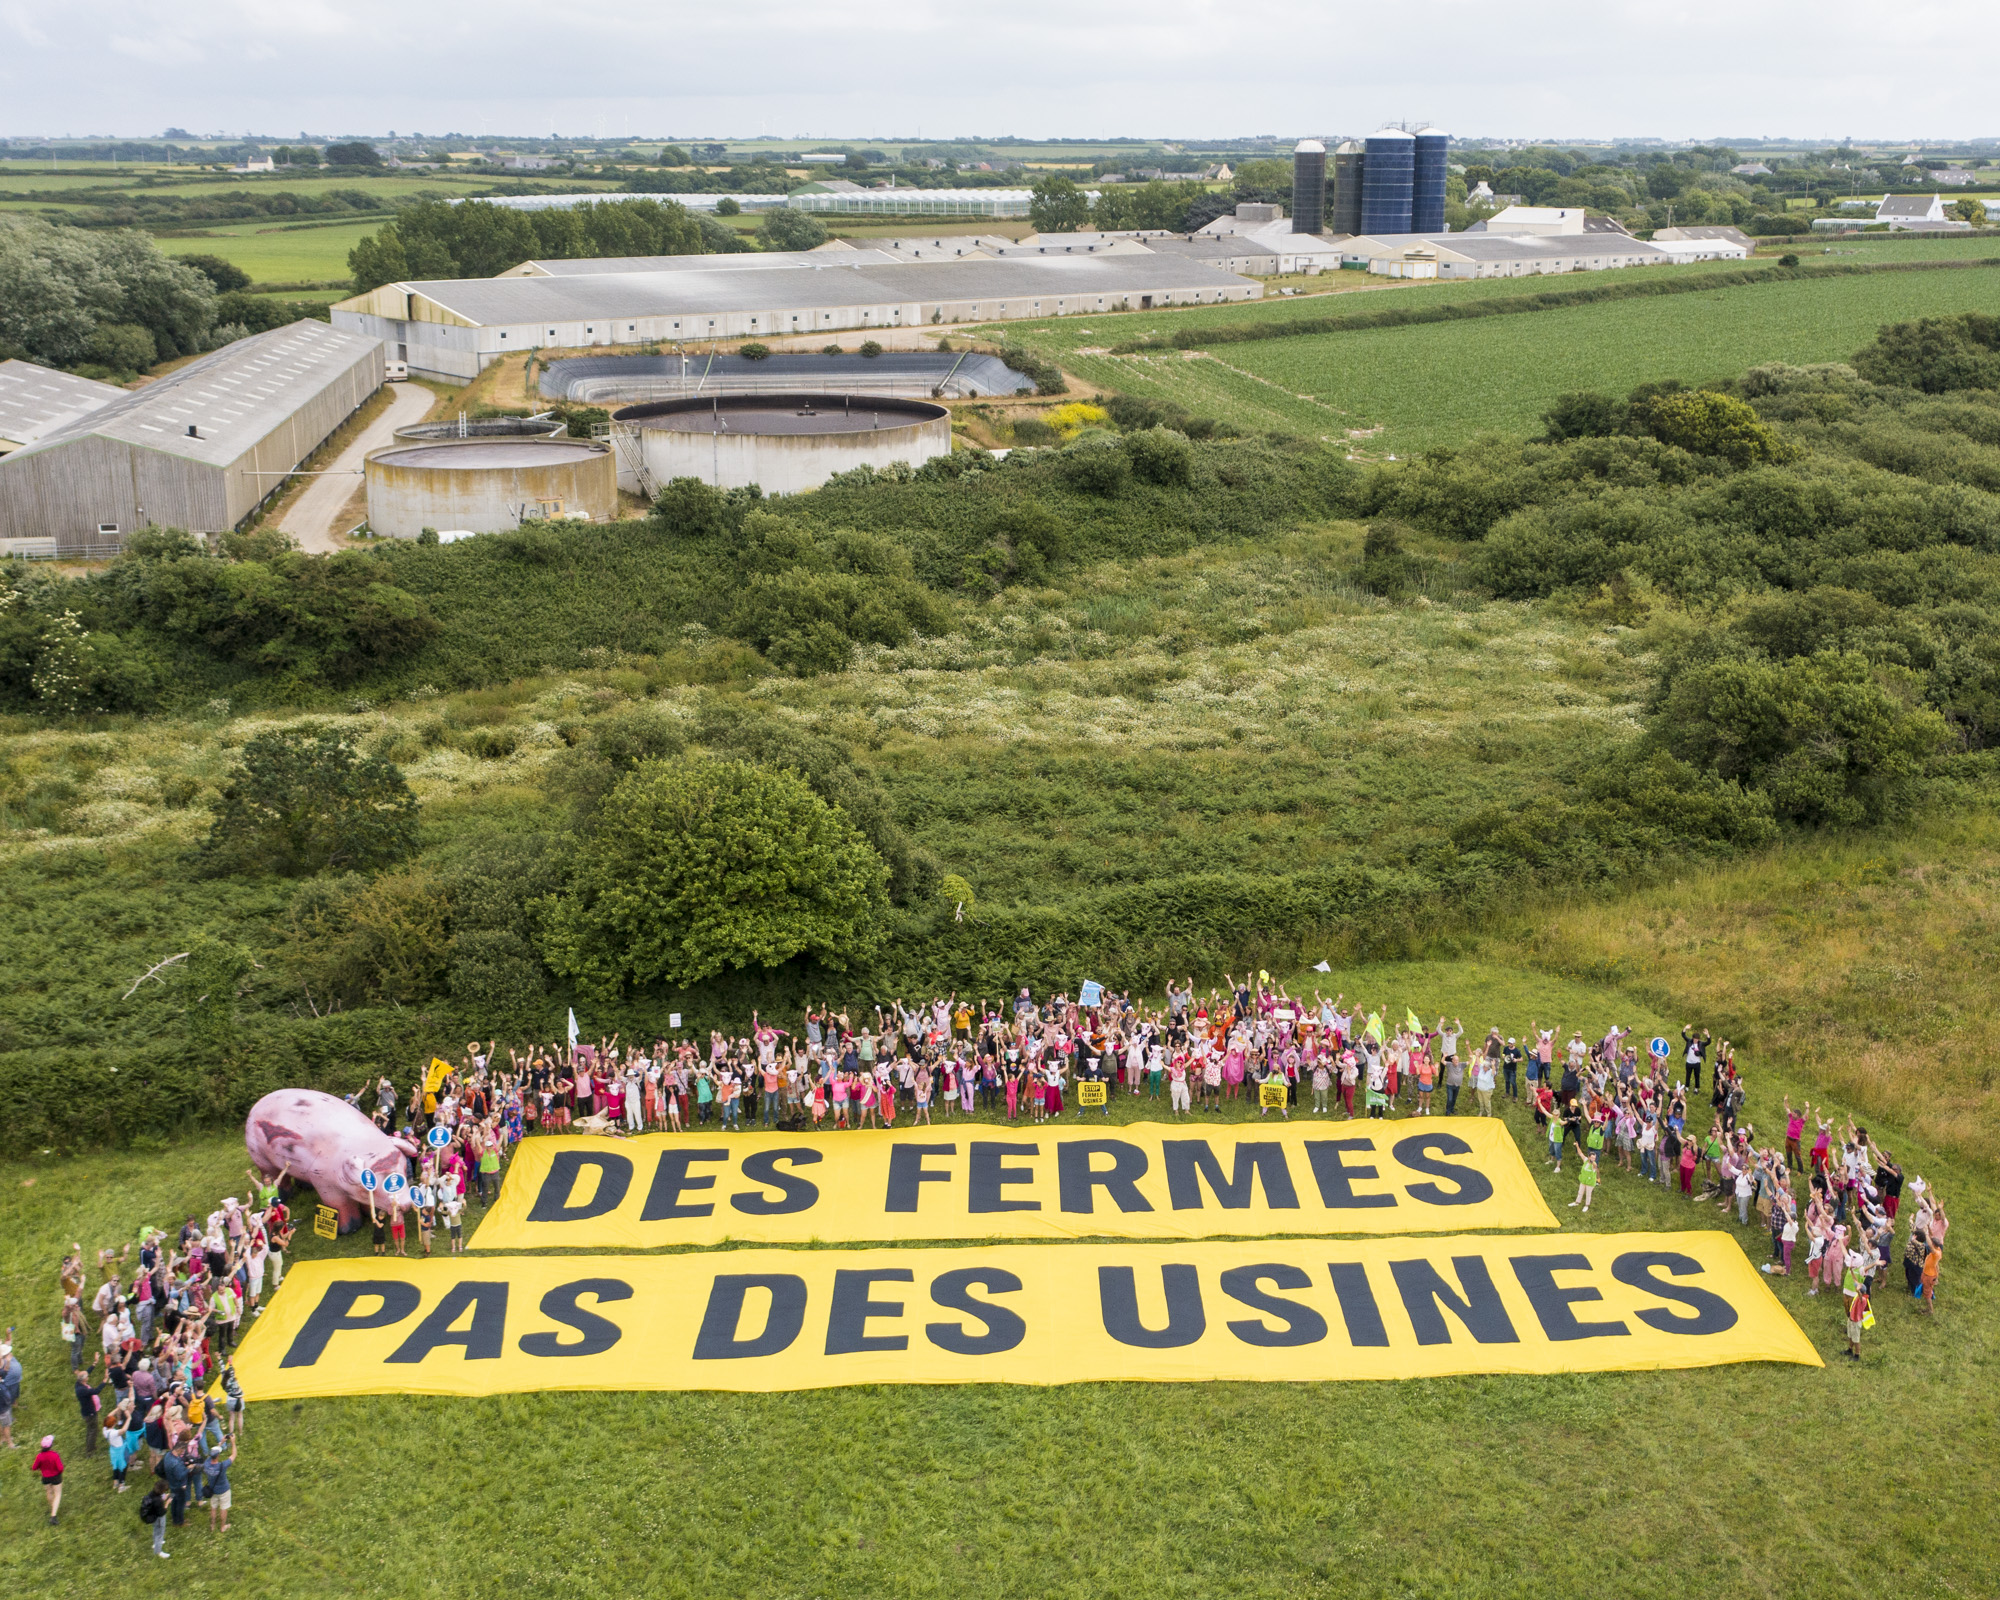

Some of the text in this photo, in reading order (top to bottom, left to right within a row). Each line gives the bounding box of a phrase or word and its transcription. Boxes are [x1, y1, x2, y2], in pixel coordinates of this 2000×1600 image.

[319, 1209, 335, 1219] STOP
[527, 1134, 1492, 1221] DES FERMES
[279, 1253, 1738, 1368] PAS DES USINES
